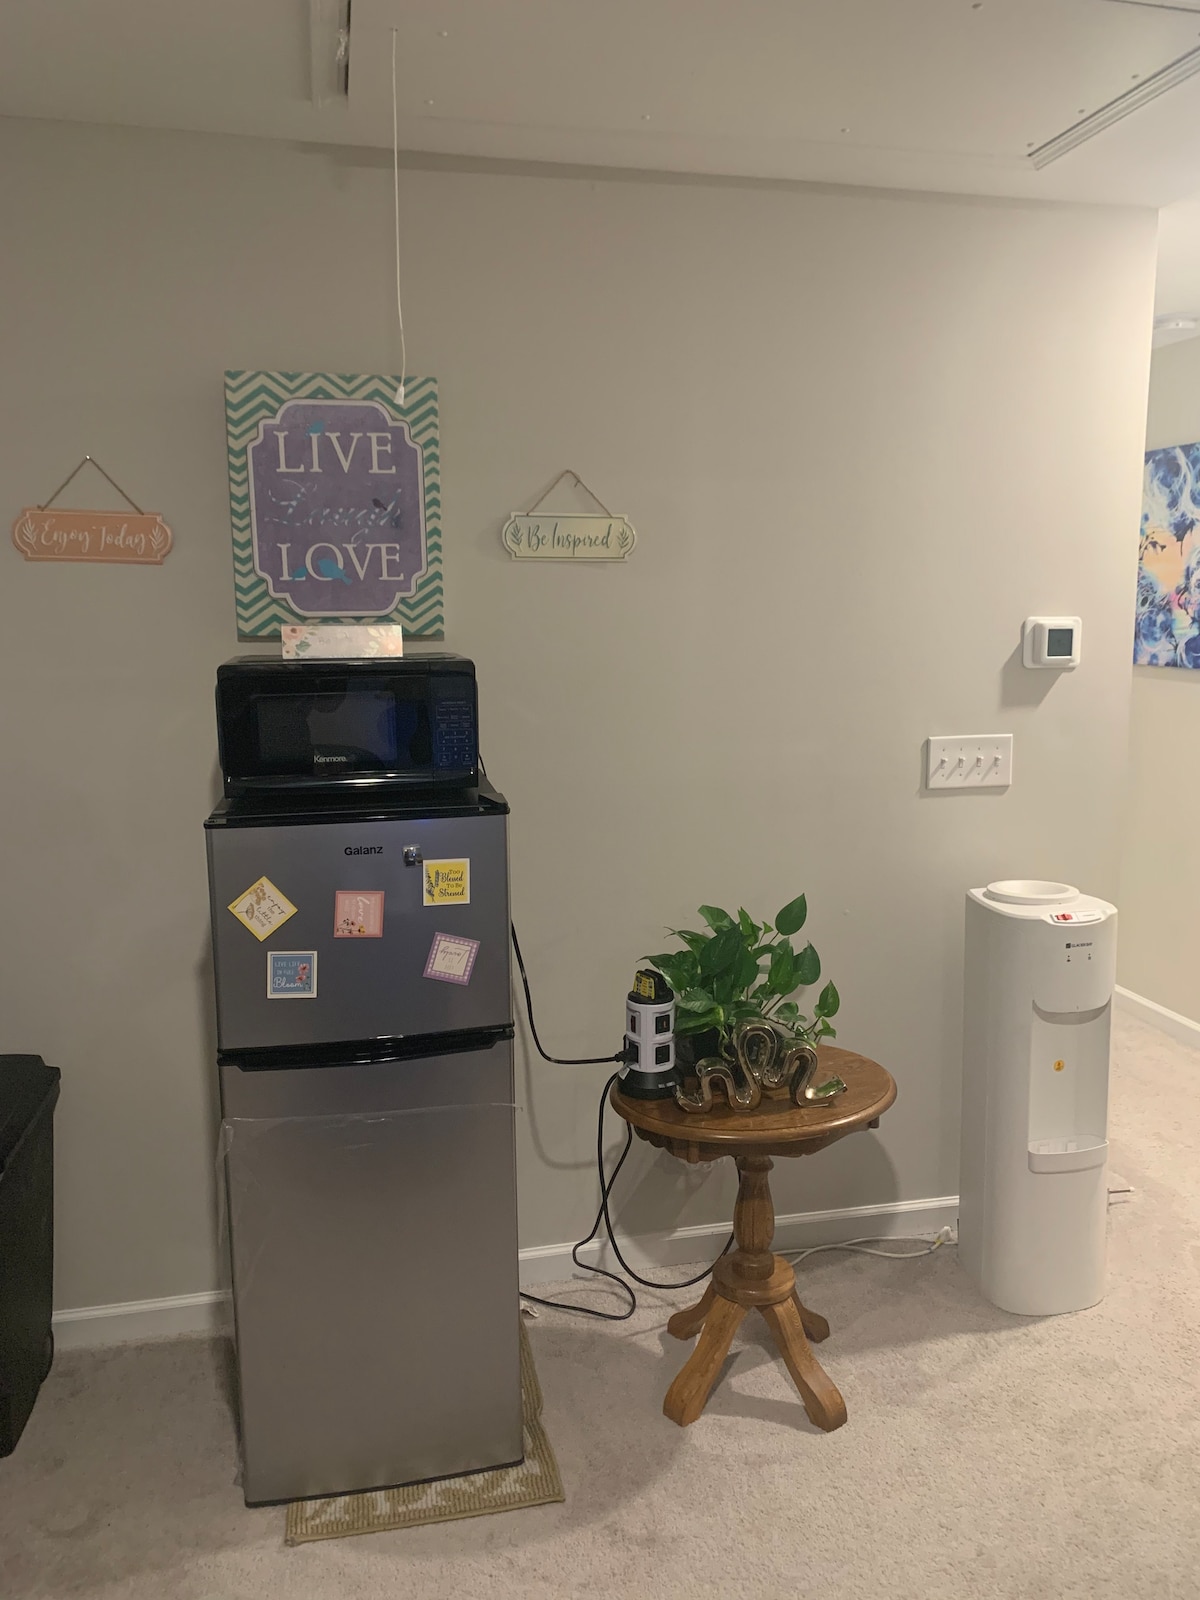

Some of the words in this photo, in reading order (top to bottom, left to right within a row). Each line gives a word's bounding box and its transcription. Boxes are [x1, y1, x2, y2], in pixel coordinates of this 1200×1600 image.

[273, 431, 397, 474] LIVE
[40, 518, 90, 555] Enjoy
[92, 523, 146, 556] Today
[527, 524, 549, 552] Be
[552, 522, 613, 556] Inspired
[276, 542, 404, 583] LOVE
[313, 754, 347, 763] Kenmore
[344, 845, 384, 856] Galanz
[273, 976, 304, 988] Bloom
